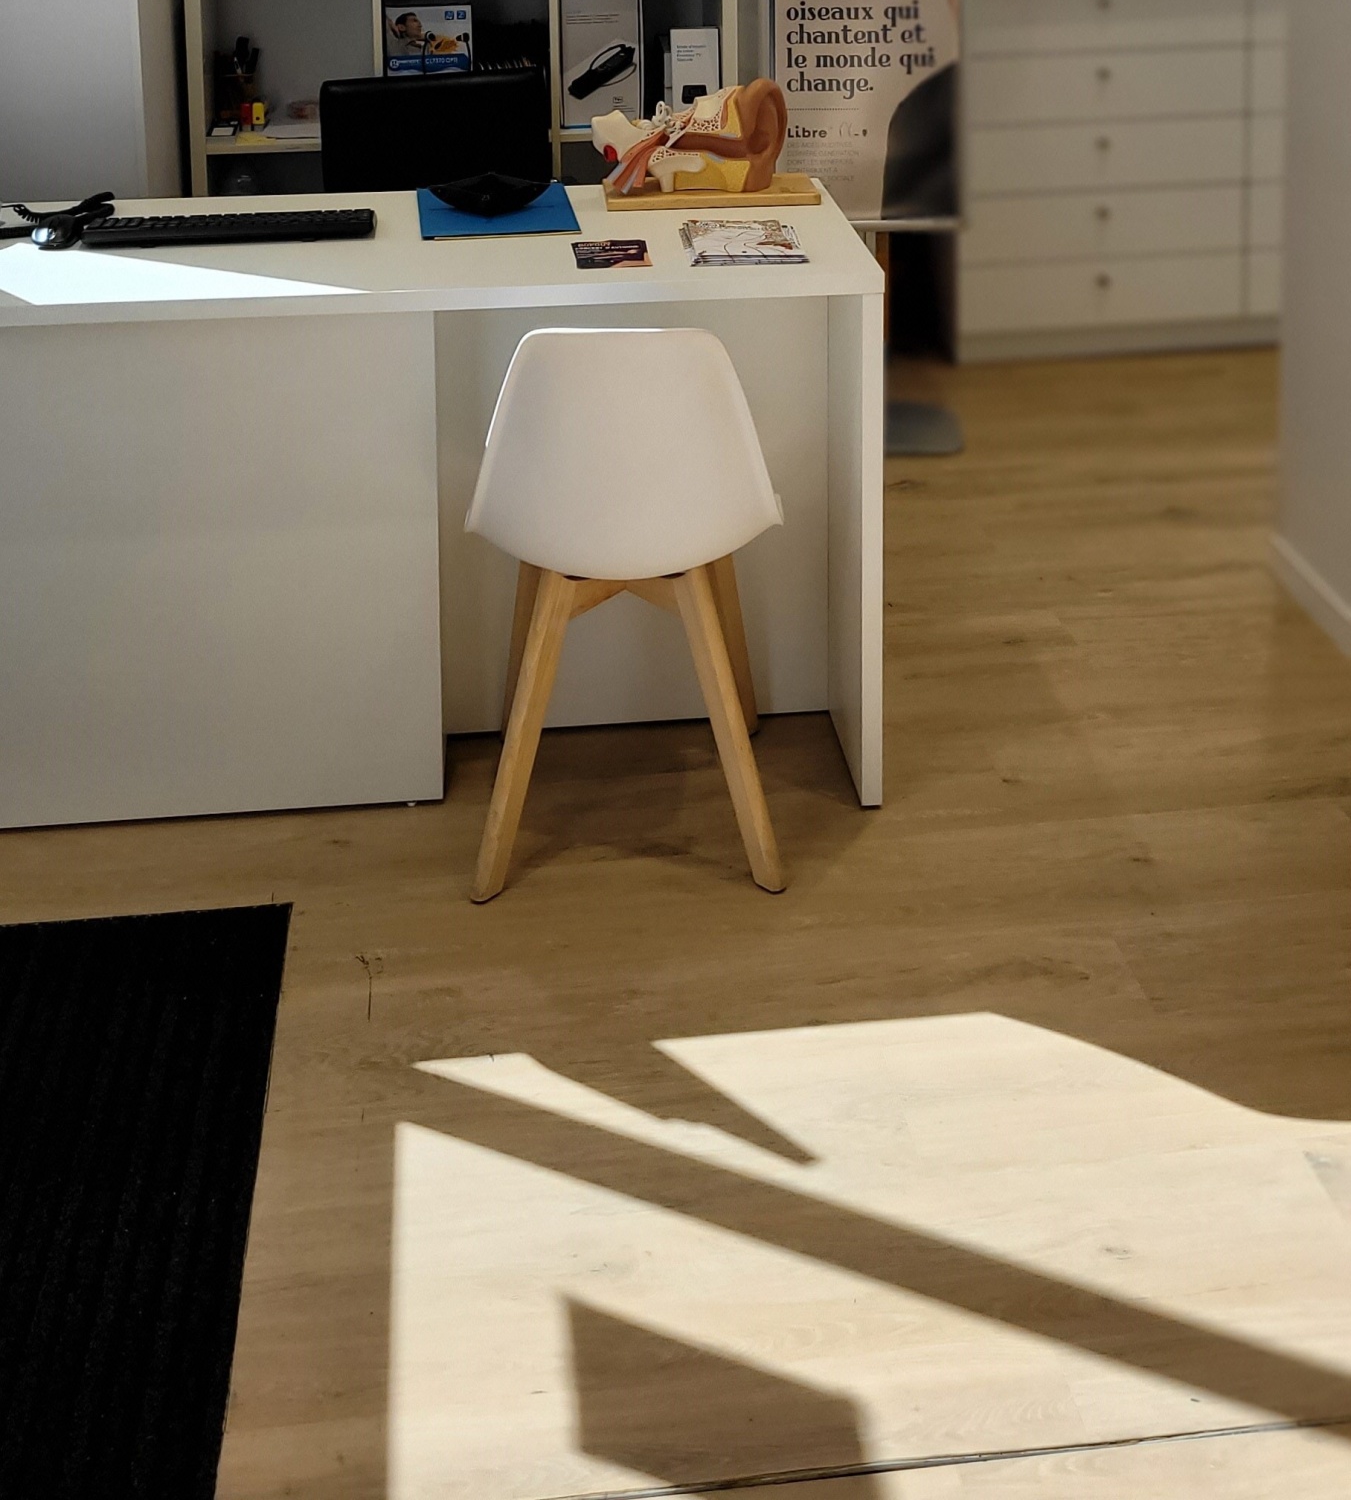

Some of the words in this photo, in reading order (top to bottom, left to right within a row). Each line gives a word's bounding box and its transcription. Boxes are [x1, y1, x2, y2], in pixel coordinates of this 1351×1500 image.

[786, 1, 874, 20] oiseaux
[884, 0, 920, 27] qui
[786, 24, 893, 44] chantent
[900, 24, 927, 44] et
[786, 48, 808, 68] le
[815, 46, 891, 68] monde
[899, 46, 935, 75] qui
[786, 72, 874, 100] change.
[787, 125, 828, 138] Libre
